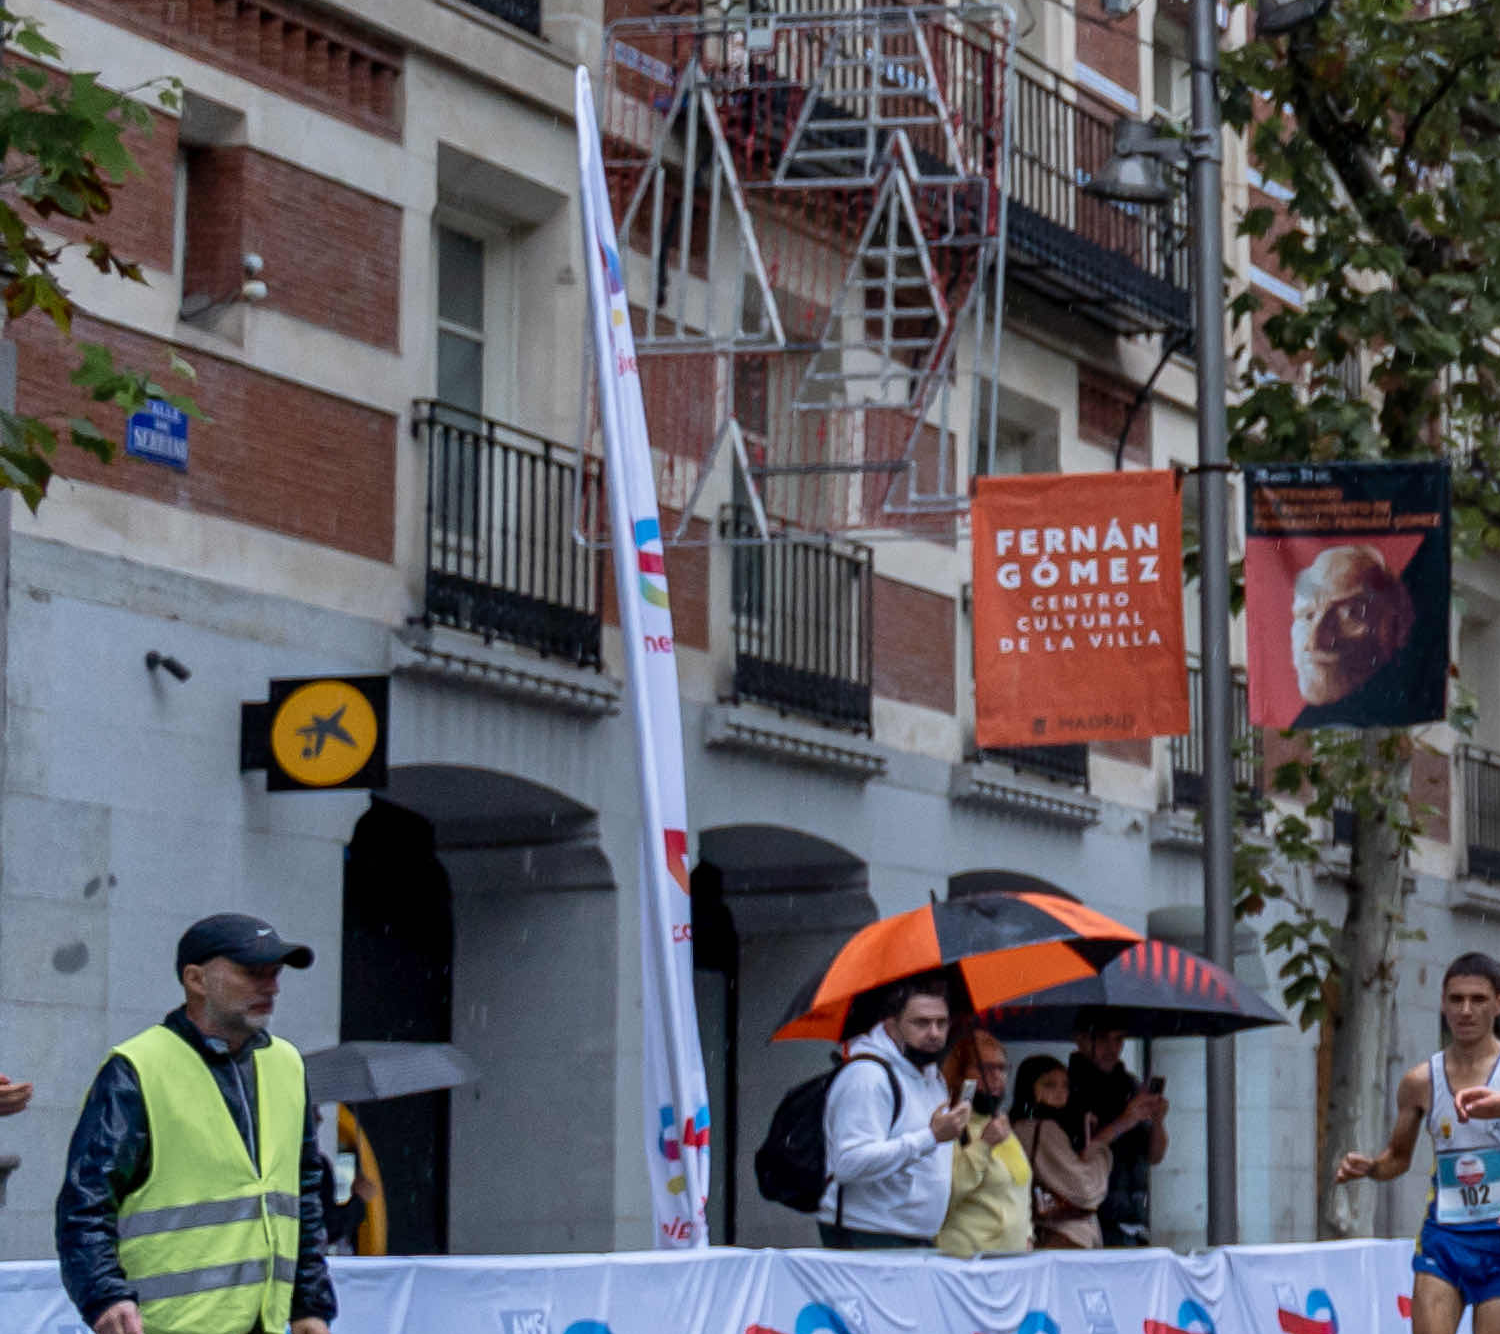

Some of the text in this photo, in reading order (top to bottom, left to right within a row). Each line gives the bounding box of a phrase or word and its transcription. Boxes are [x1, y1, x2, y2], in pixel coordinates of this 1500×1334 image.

[996, 517, 1159, 556] FERNÁN
[996, 555, 1160, 589] GÓMEZ
[1031, 592, 1130, 611] CENTRO
[1016, 612, 1144, 633] CULTURAL
[1000, 630, 1161, 654] DE LA VILLA
[1459, 1184, 1491, 1208] 102
